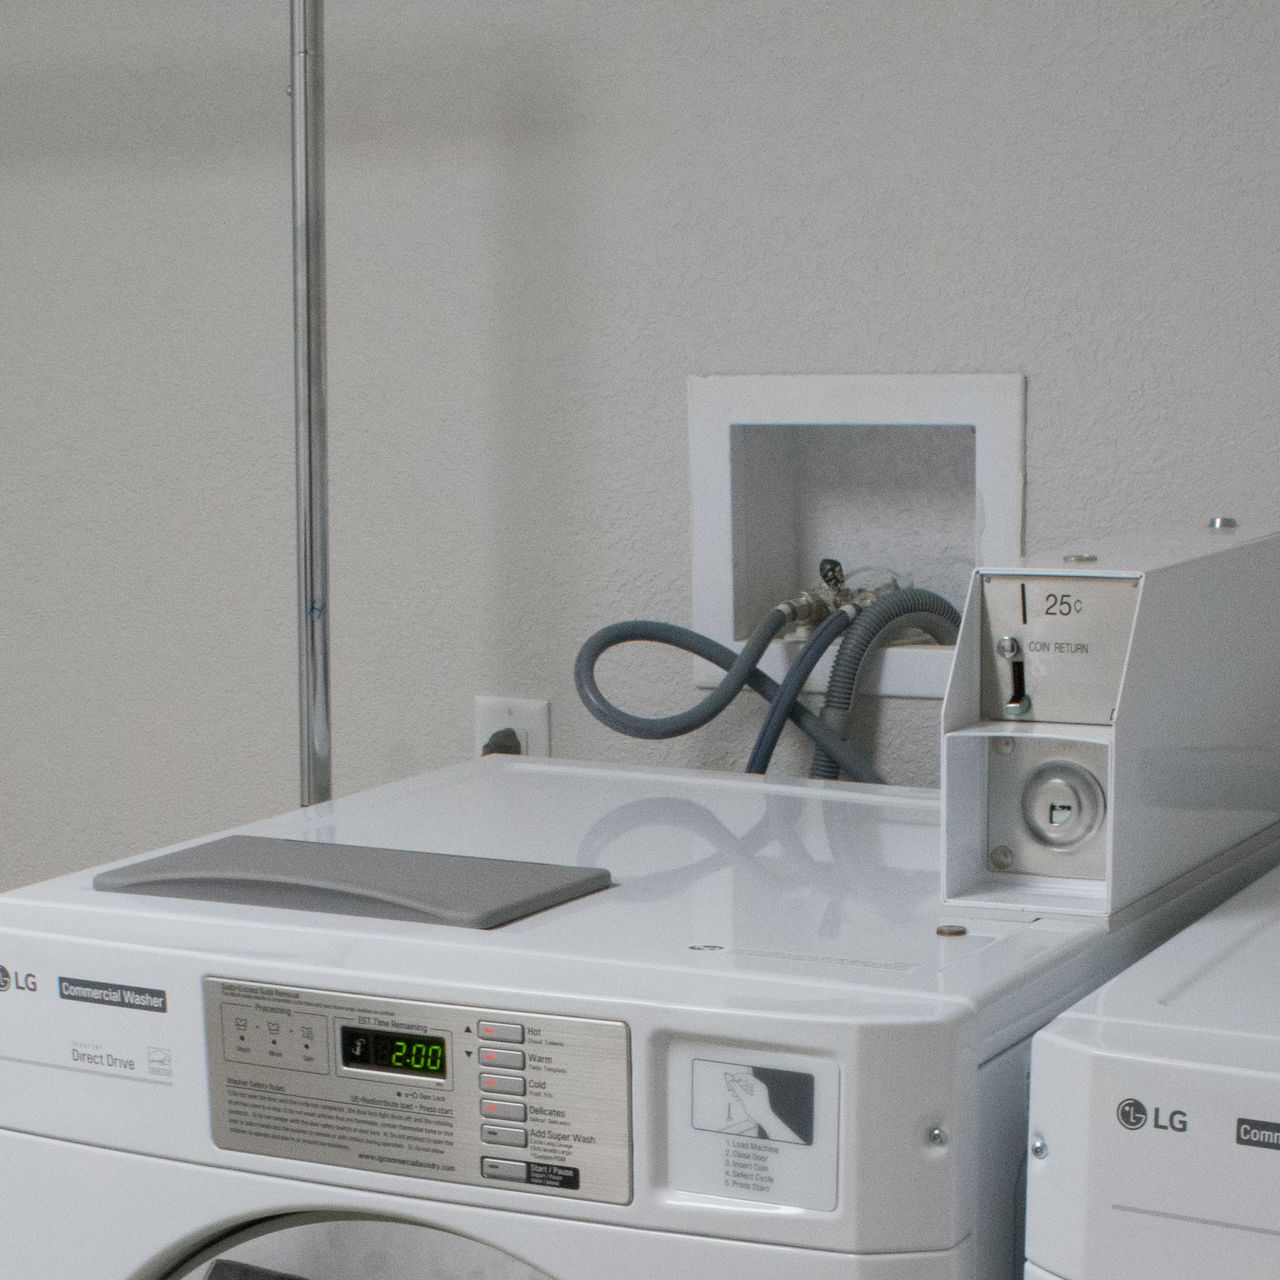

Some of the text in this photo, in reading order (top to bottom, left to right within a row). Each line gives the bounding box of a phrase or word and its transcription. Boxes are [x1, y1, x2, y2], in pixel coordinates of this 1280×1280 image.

[1029, 641, 1089, 655] COIN RETURN
[14, 971, 38, 992] LG
[62, 982, 164, 1008] Commercial Washer
[254, 1003, 292, 1017] Processing
[373, 1018, 390, 1028] Time
[391, 1020, 428, 1033] Remaining
[527, 1027, 542, 1037] Hot
[72, 1048, 136, 1070] Direct Drive
[528, 1054, 553, 1064] Warm
[529, 1080, 547, 1089] Cold
[438, 1106, 453, 1115] start
[530, 1106, 566, 1118] Delicates
[1153, 1107, 1188, 1132] LG
[530, 1129, 596, 1144] Add Super Wash
[752, 1153, 768, 1161] Door
[530, 1164, 547, 1173] Start
[553, 1167, 574, 1177] Pause
[732, 1160, 752, 1169] Insert
[754, 1163, 769, 1172] Coin
[732, 1170, 754, 1180] Select
[755, 1173, 774, 1184] Cycle
[752, 1183, 770, 1192] Start
